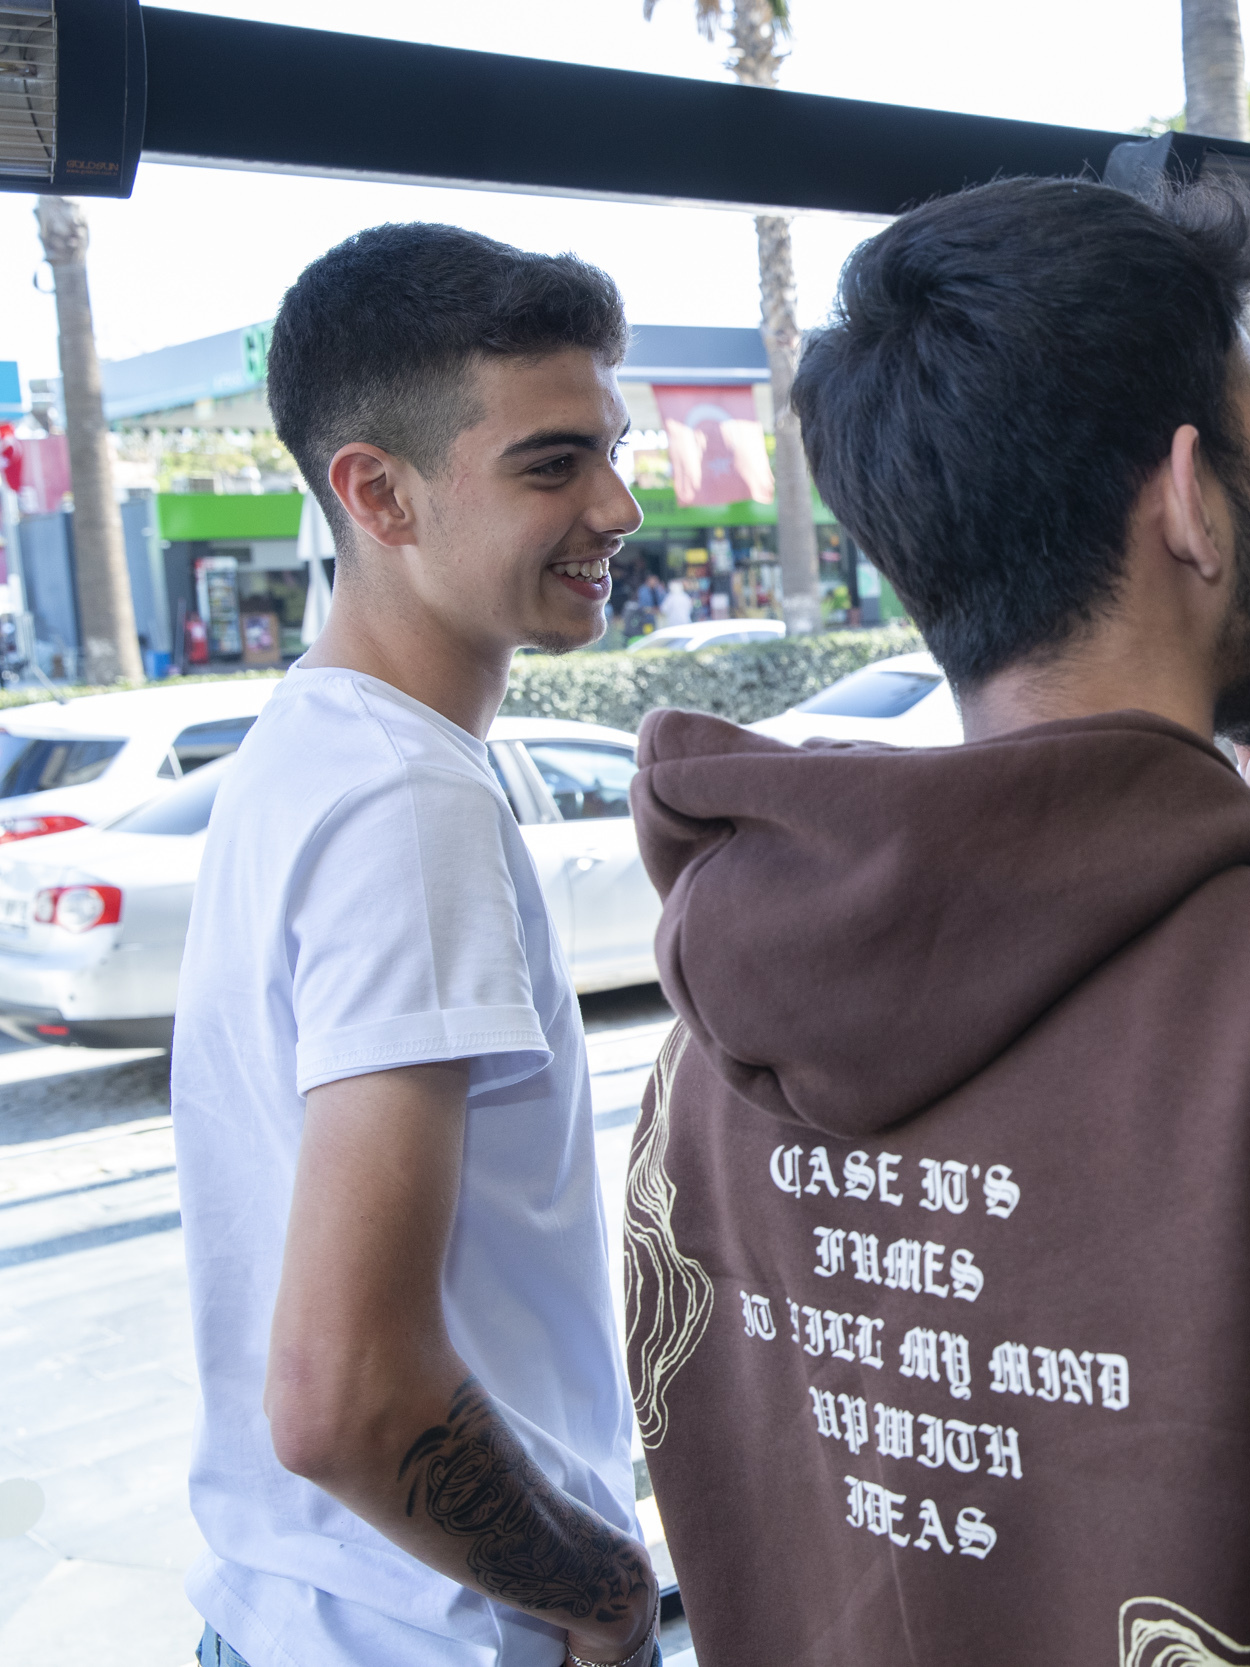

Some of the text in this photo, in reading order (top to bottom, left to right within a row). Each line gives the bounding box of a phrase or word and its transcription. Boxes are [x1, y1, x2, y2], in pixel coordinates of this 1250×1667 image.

[769, 1144, 1021, 1219] CASE IT'S
[813, 1226, 984, 1302] FUMES
[899, 1326, 971, 1400] MY
[989, 1340, 1130, 1411] MIND
[843, 1475, 997, 1559] IDEAS
